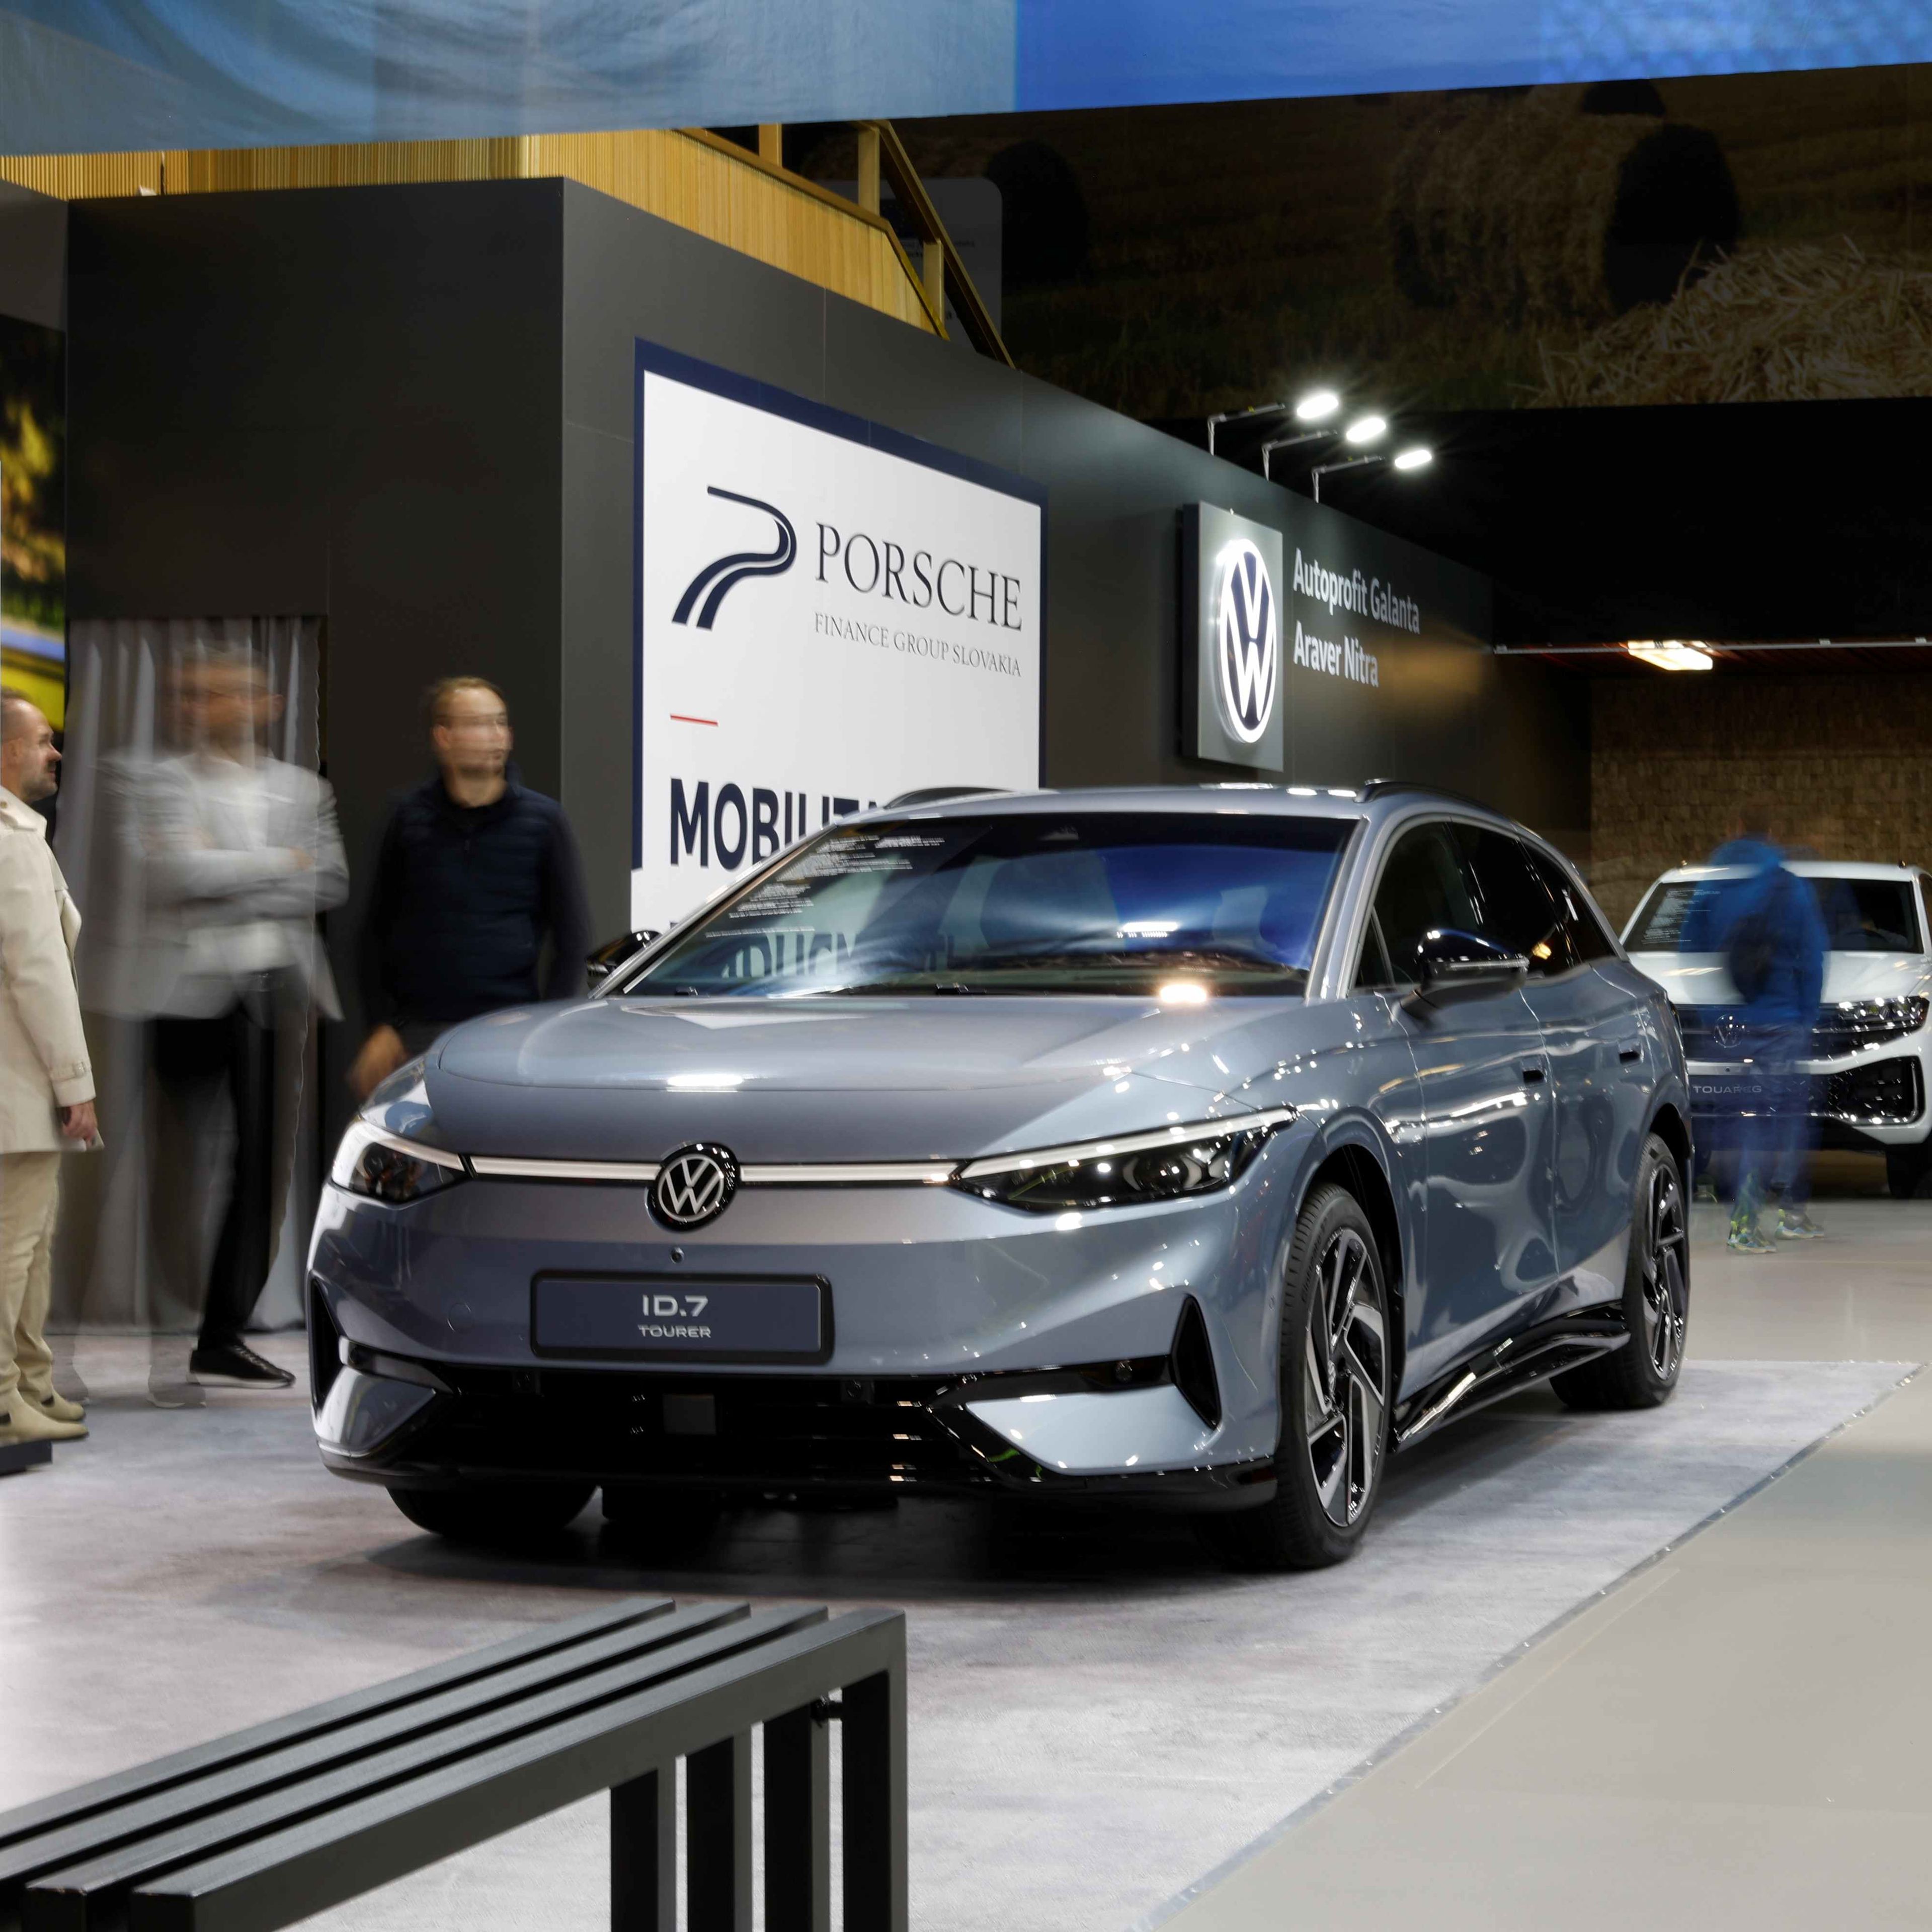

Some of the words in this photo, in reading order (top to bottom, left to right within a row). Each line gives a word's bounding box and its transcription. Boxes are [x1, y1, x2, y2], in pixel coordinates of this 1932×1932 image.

[815, 521, 1022, 632] PORSCHE
[1293, 547, 1368, 617] Autoprofit
[1371, 577, 1420, 634] Galanta
[815, 612, 889, 648] FINANCE
[893, 631, 950, 661] GROUP
[952, 644, 1022, 677] SLOVAKIA
[1293, 620, 1342, 676] Araver
[1344, 635, 1379, 688] Nitra
[637, 1325, 711, 1338] TOURER
[642, 1295, 708, 1317] ID.7
